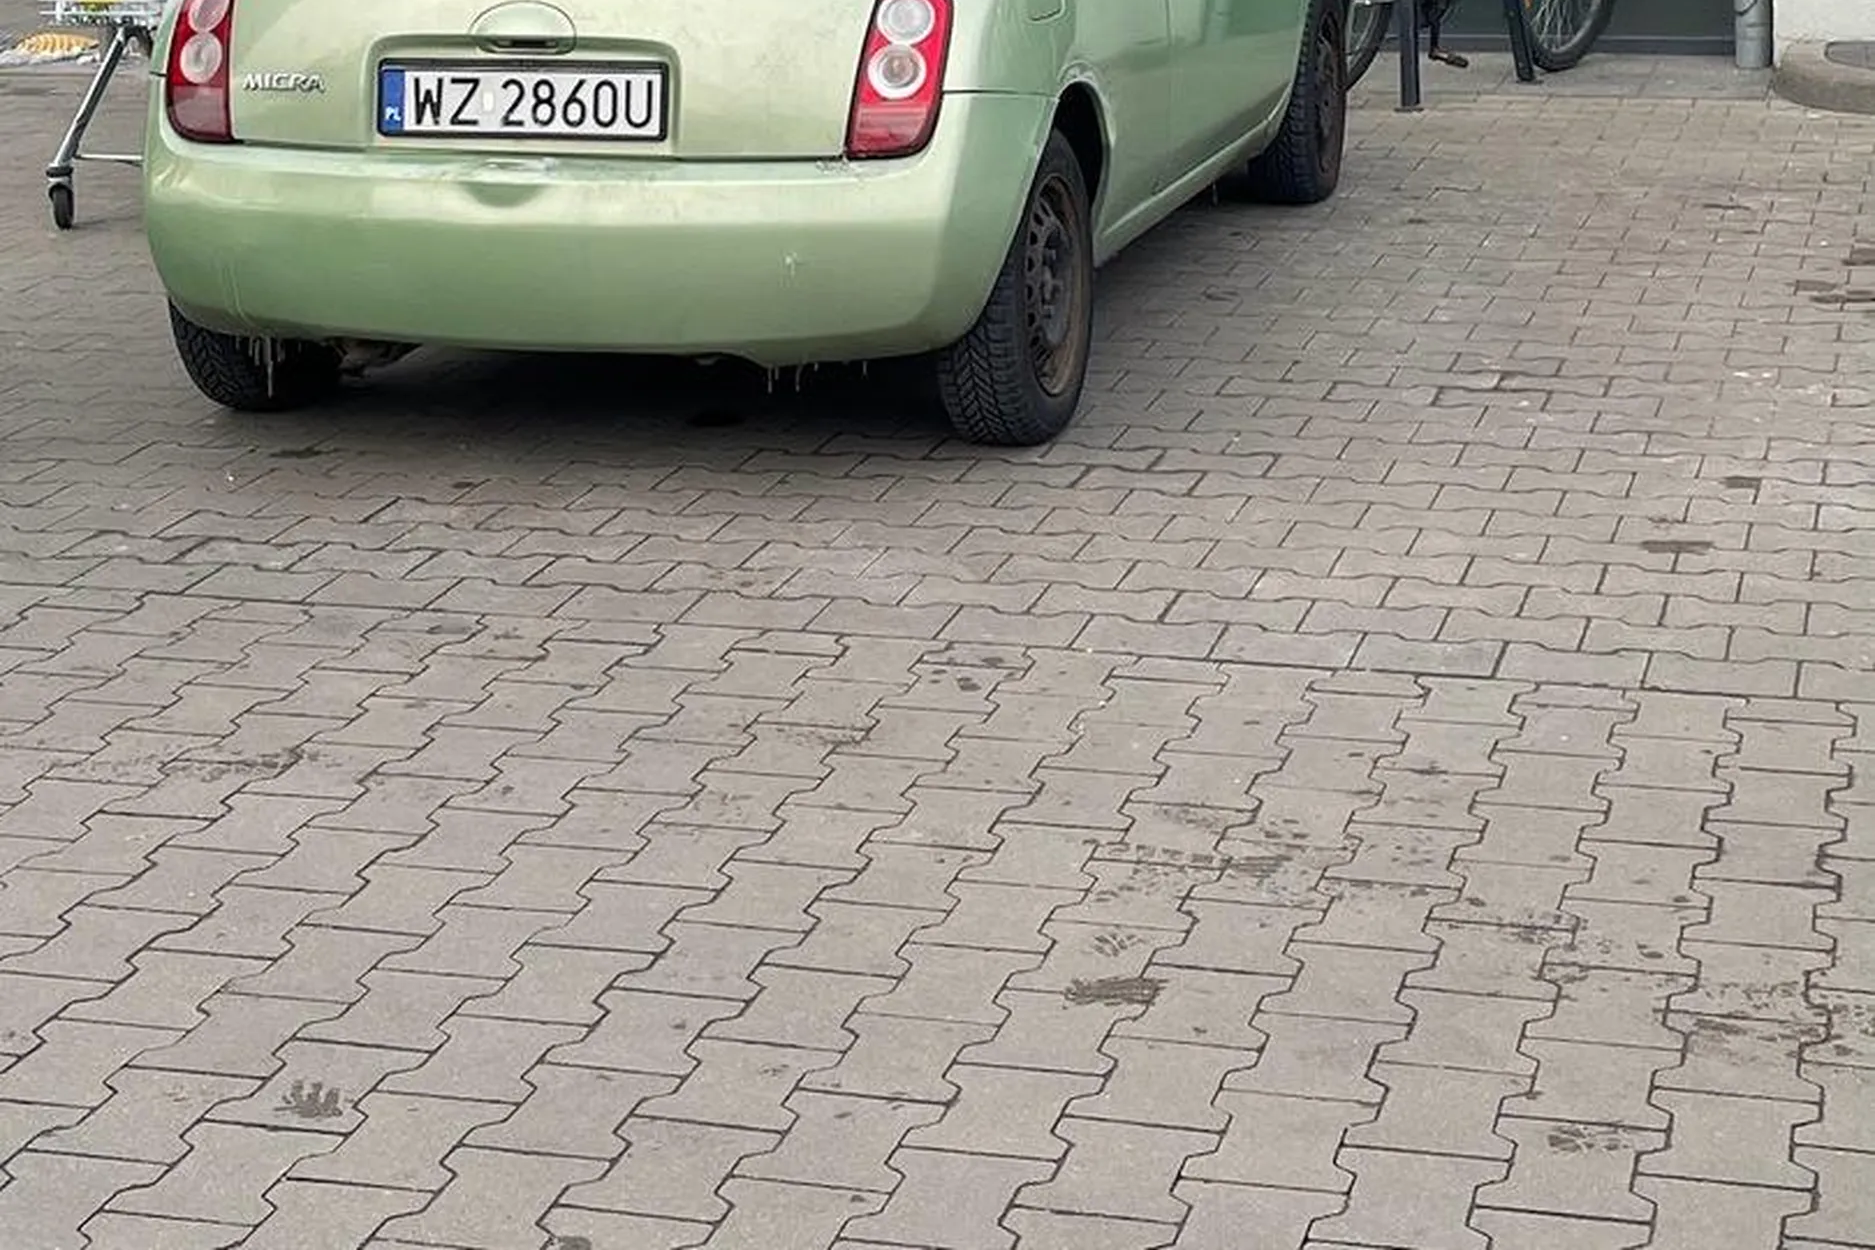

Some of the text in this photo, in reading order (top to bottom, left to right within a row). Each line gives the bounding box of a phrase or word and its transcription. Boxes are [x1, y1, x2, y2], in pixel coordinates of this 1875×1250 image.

[242, 72, 326, 93] MICRA
[385, 106, 401, 121] PL
[414, 77, 653, 129] WZ 2860U
